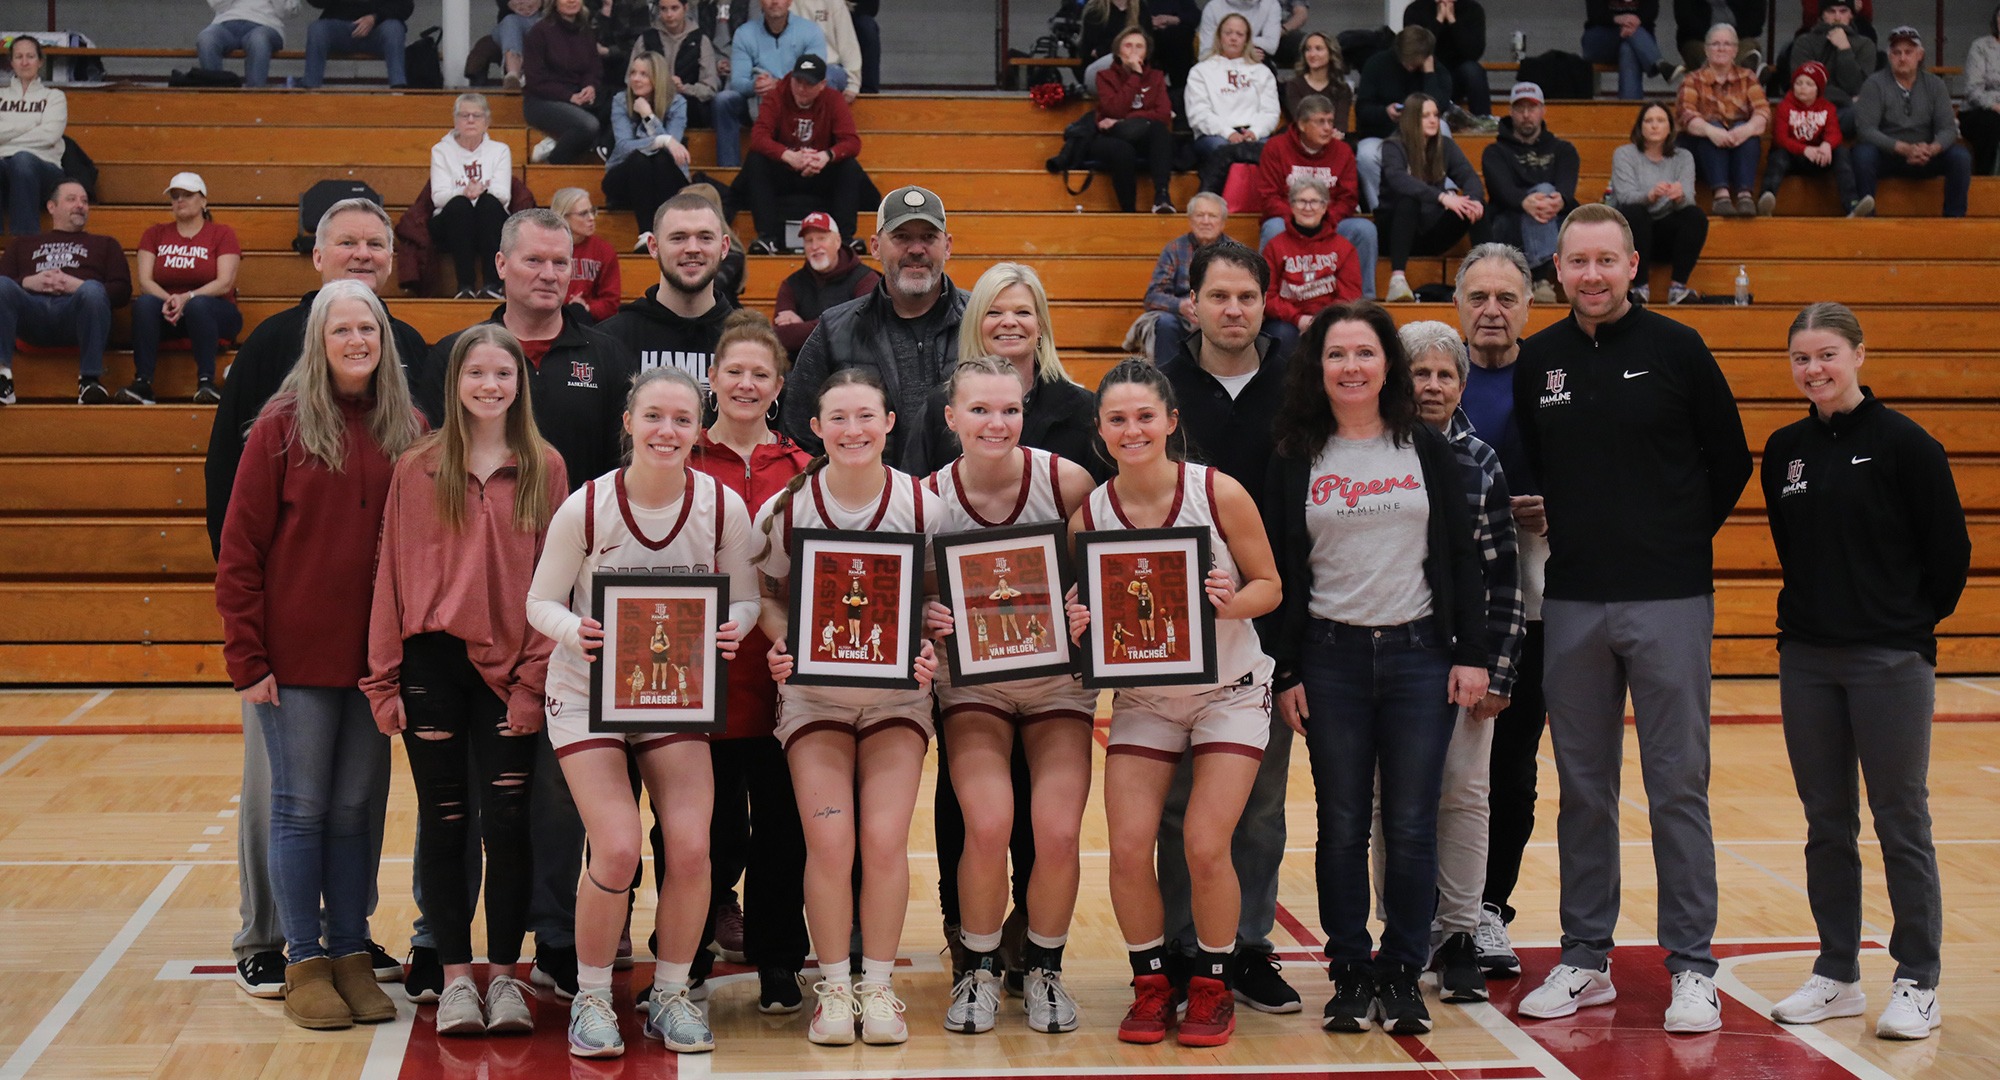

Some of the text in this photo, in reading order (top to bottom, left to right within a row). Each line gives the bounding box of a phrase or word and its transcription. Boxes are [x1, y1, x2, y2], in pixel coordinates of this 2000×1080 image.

[157, 244, 209, 260] HAMLINE
[163, 255, 196, 269] MOM
[567, 381, 599, 389] BASKETBALL
[1540, 391, 1572, 405] HAMLINE
[1312, 474, 1421, 508] Pipers
[1337, 502, 1400, 516] HAMLINE
[871, 558, 898, 624] 2025
[838, 650, 869, 660] WENSEL
[989, 643, 1034, 657] VAN HELDEN
[1127, 649, 1169, 660] TRACHSEL
[640, 695, 678, 705] DRAEGER
